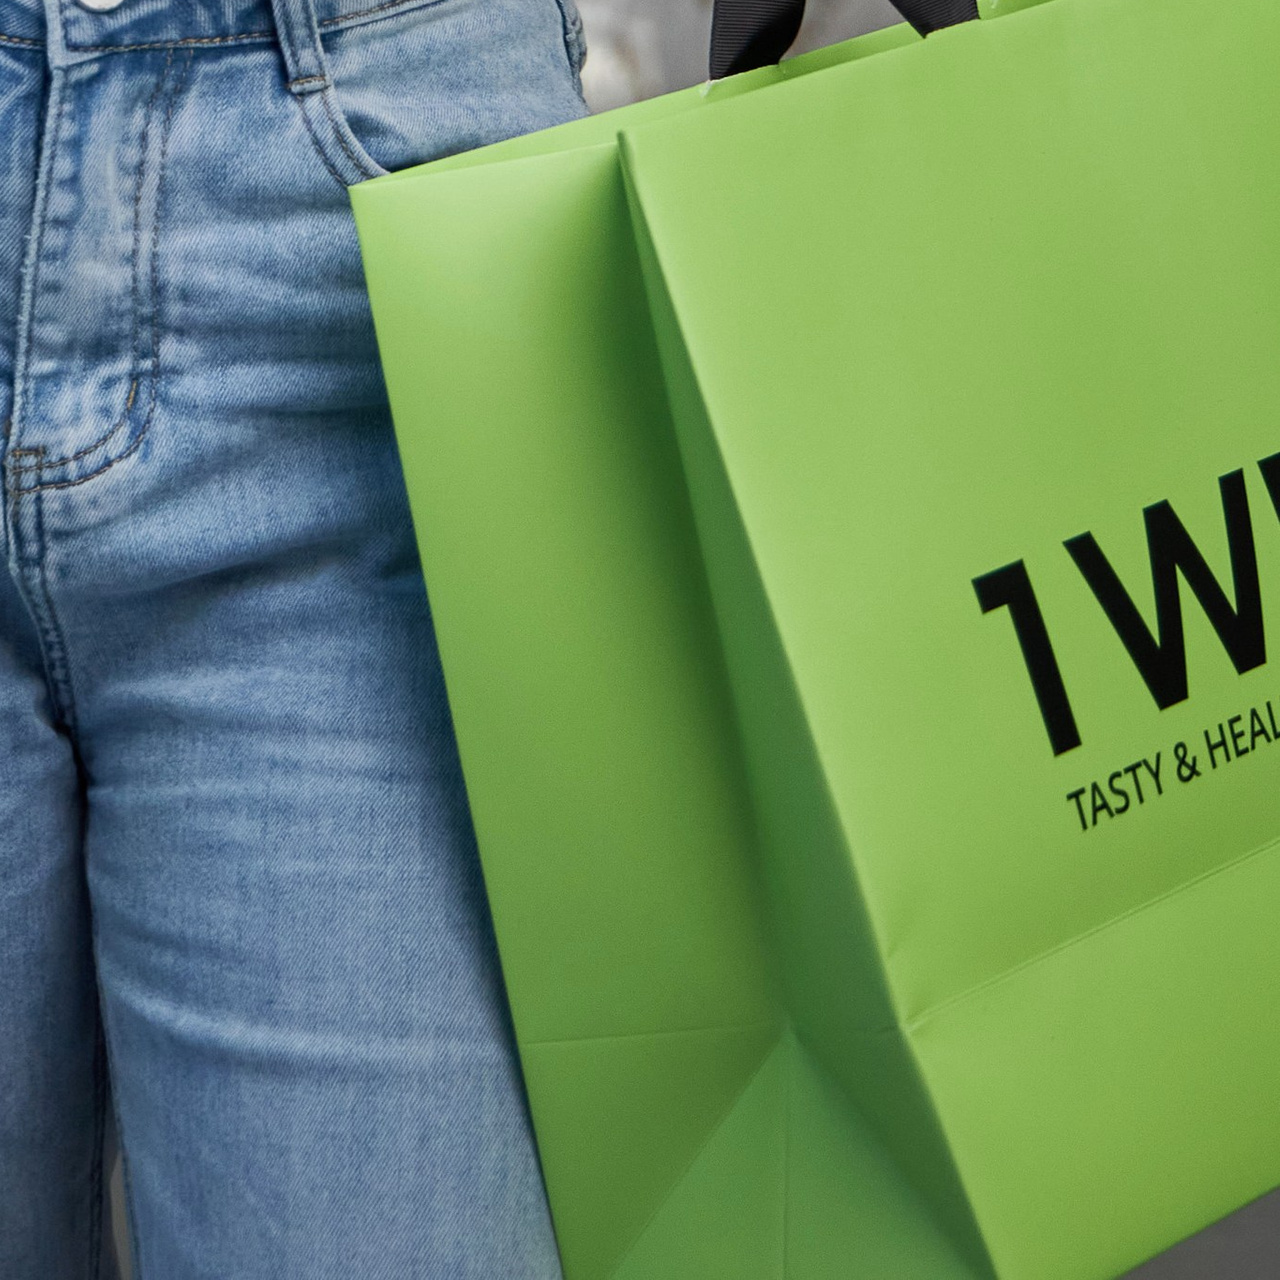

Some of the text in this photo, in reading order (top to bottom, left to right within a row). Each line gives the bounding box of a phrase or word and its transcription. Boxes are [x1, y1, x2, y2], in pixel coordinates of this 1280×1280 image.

[1066, 700, 1280, 832] TASTY & HEAL
